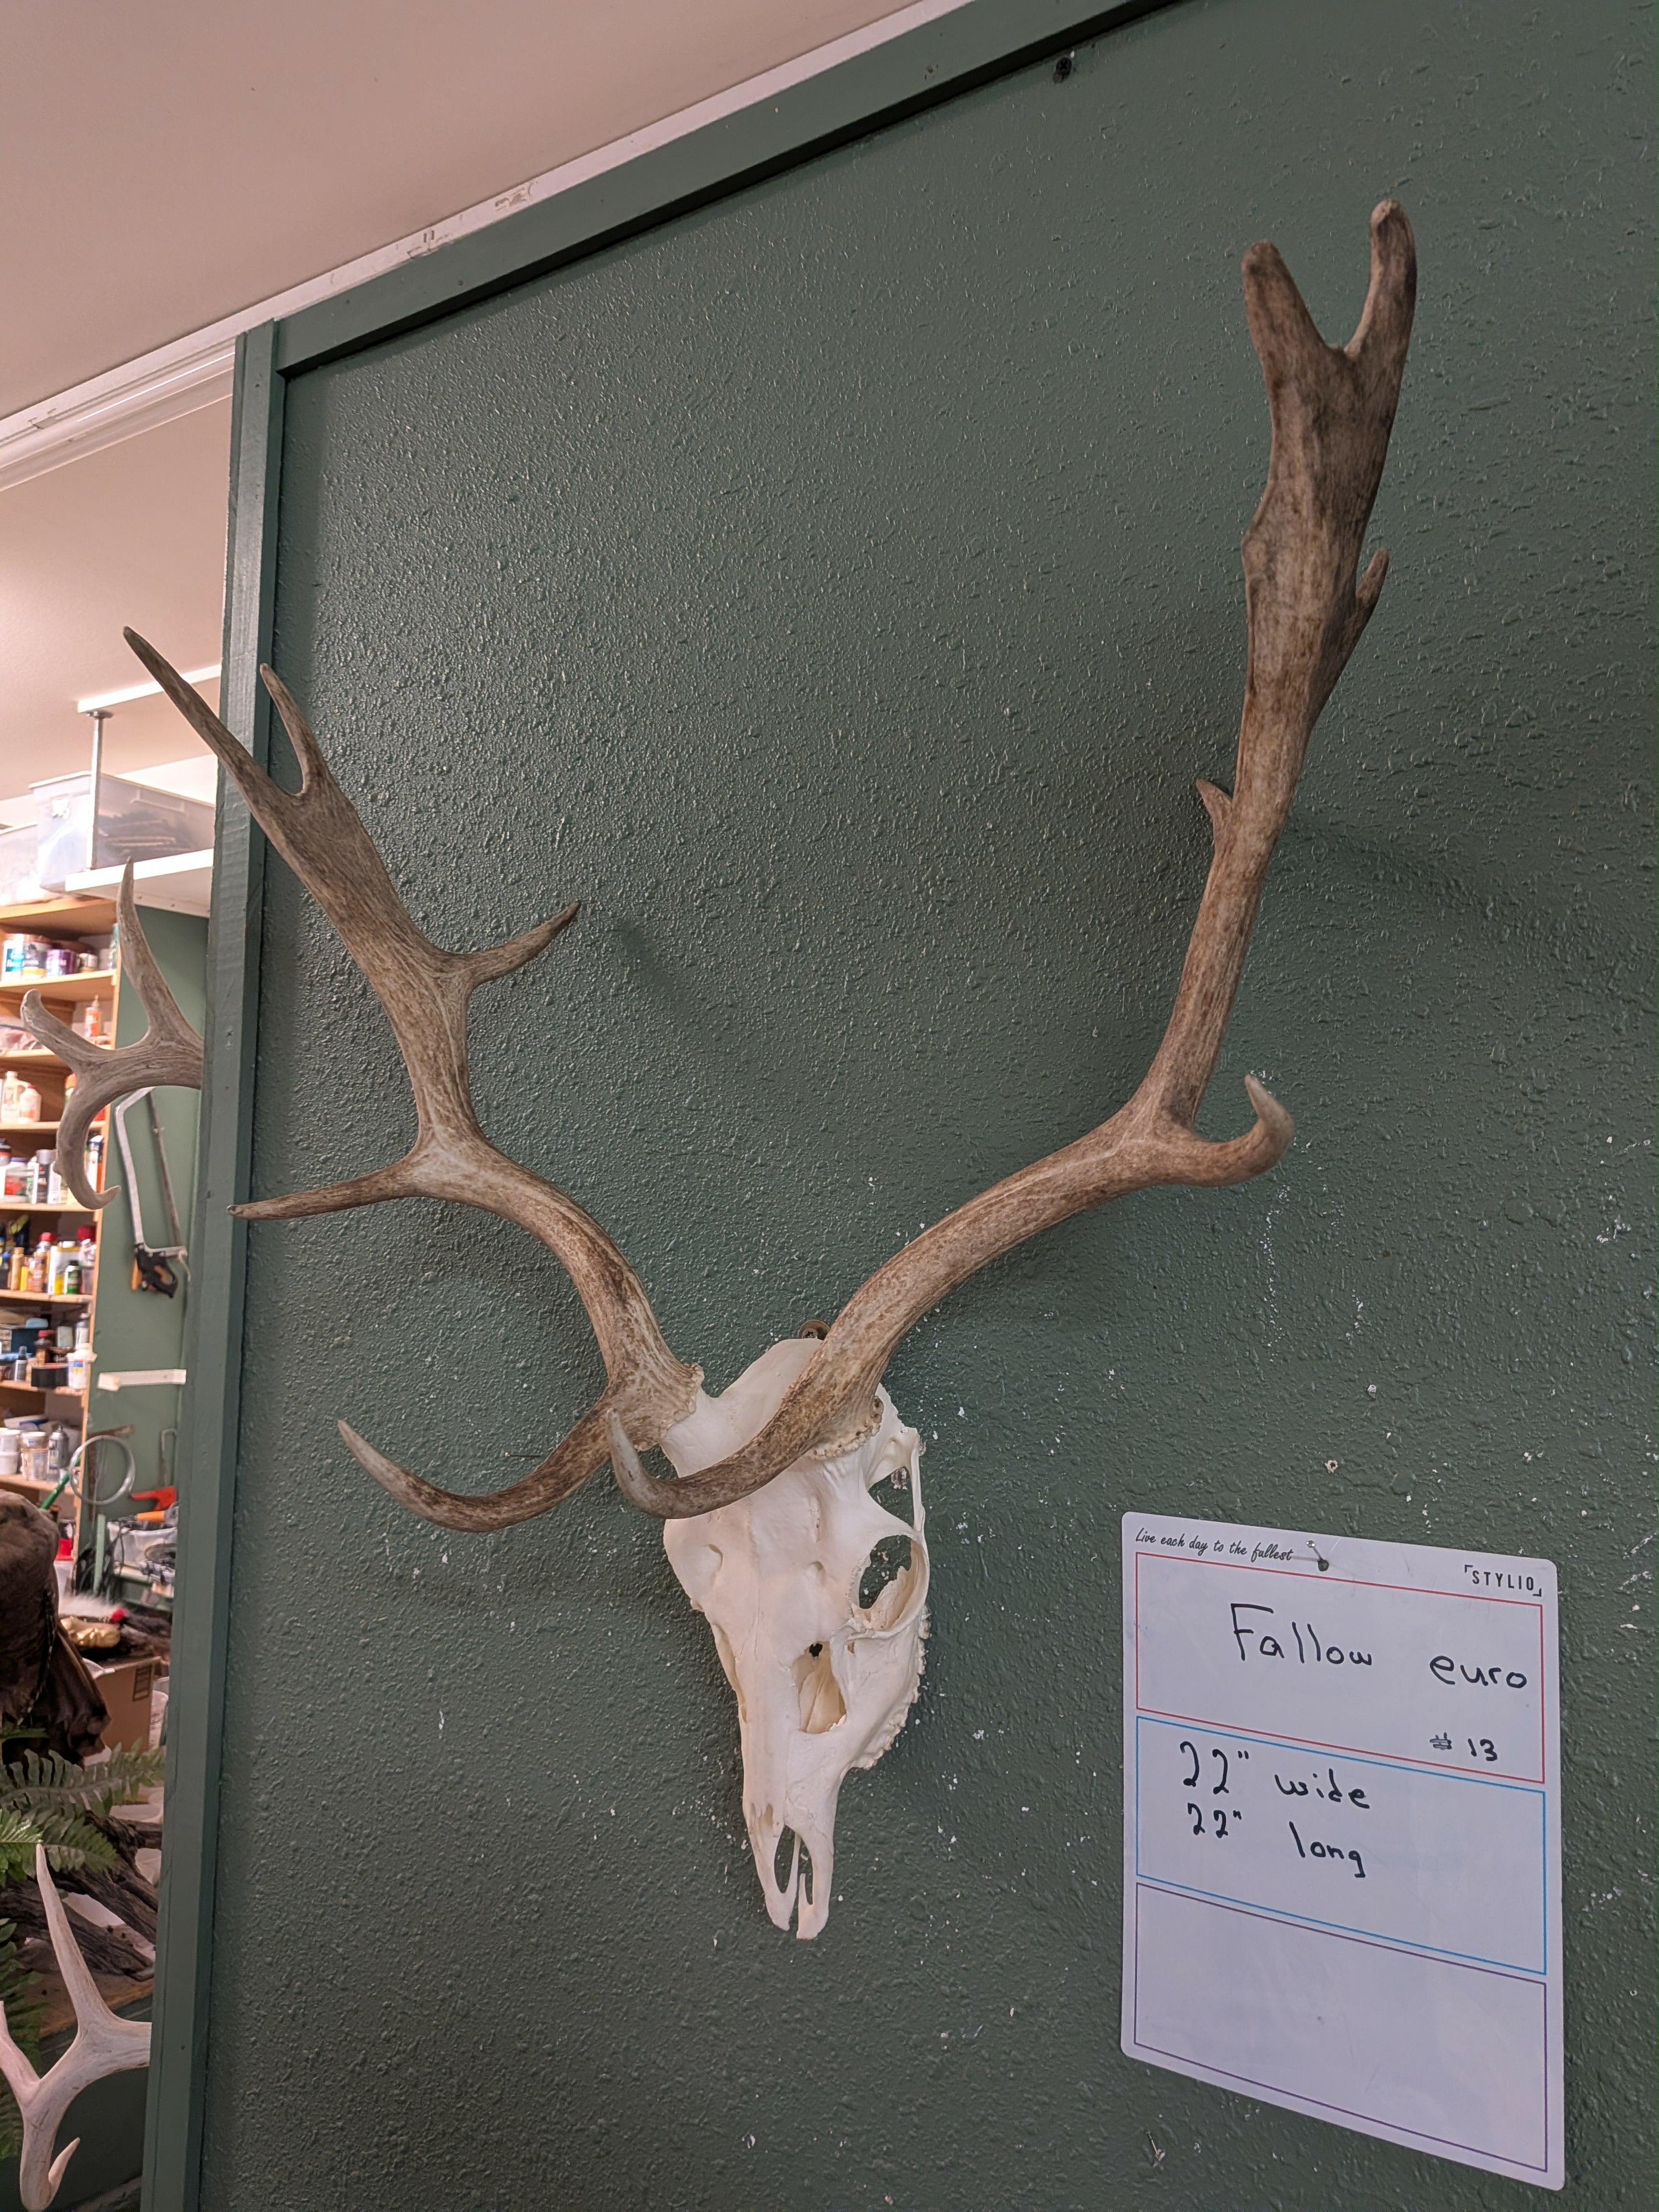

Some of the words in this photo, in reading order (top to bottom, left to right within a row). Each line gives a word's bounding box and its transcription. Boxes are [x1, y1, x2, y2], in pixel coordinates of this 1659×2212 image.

[1135, 1527, 1156, 1543] Live
[1160, 1533, 1185, 1547] each
[1188, 1535, 1208, 1557] day
[1213, 1540, 1224, 1552] to
[1229, 1540, 1248, 1555] the
[1250, 1542, 1294, 1563] fullest
[1472, 1569, 1535, 1591] STYLIO
[1230, 1602, 1373, 1666] Fallow
[1429, 1655, 1528, 1689] euro
[1274, 1768, 1370, 1809] wide
[1288, 1821, 1366, 1879] long
